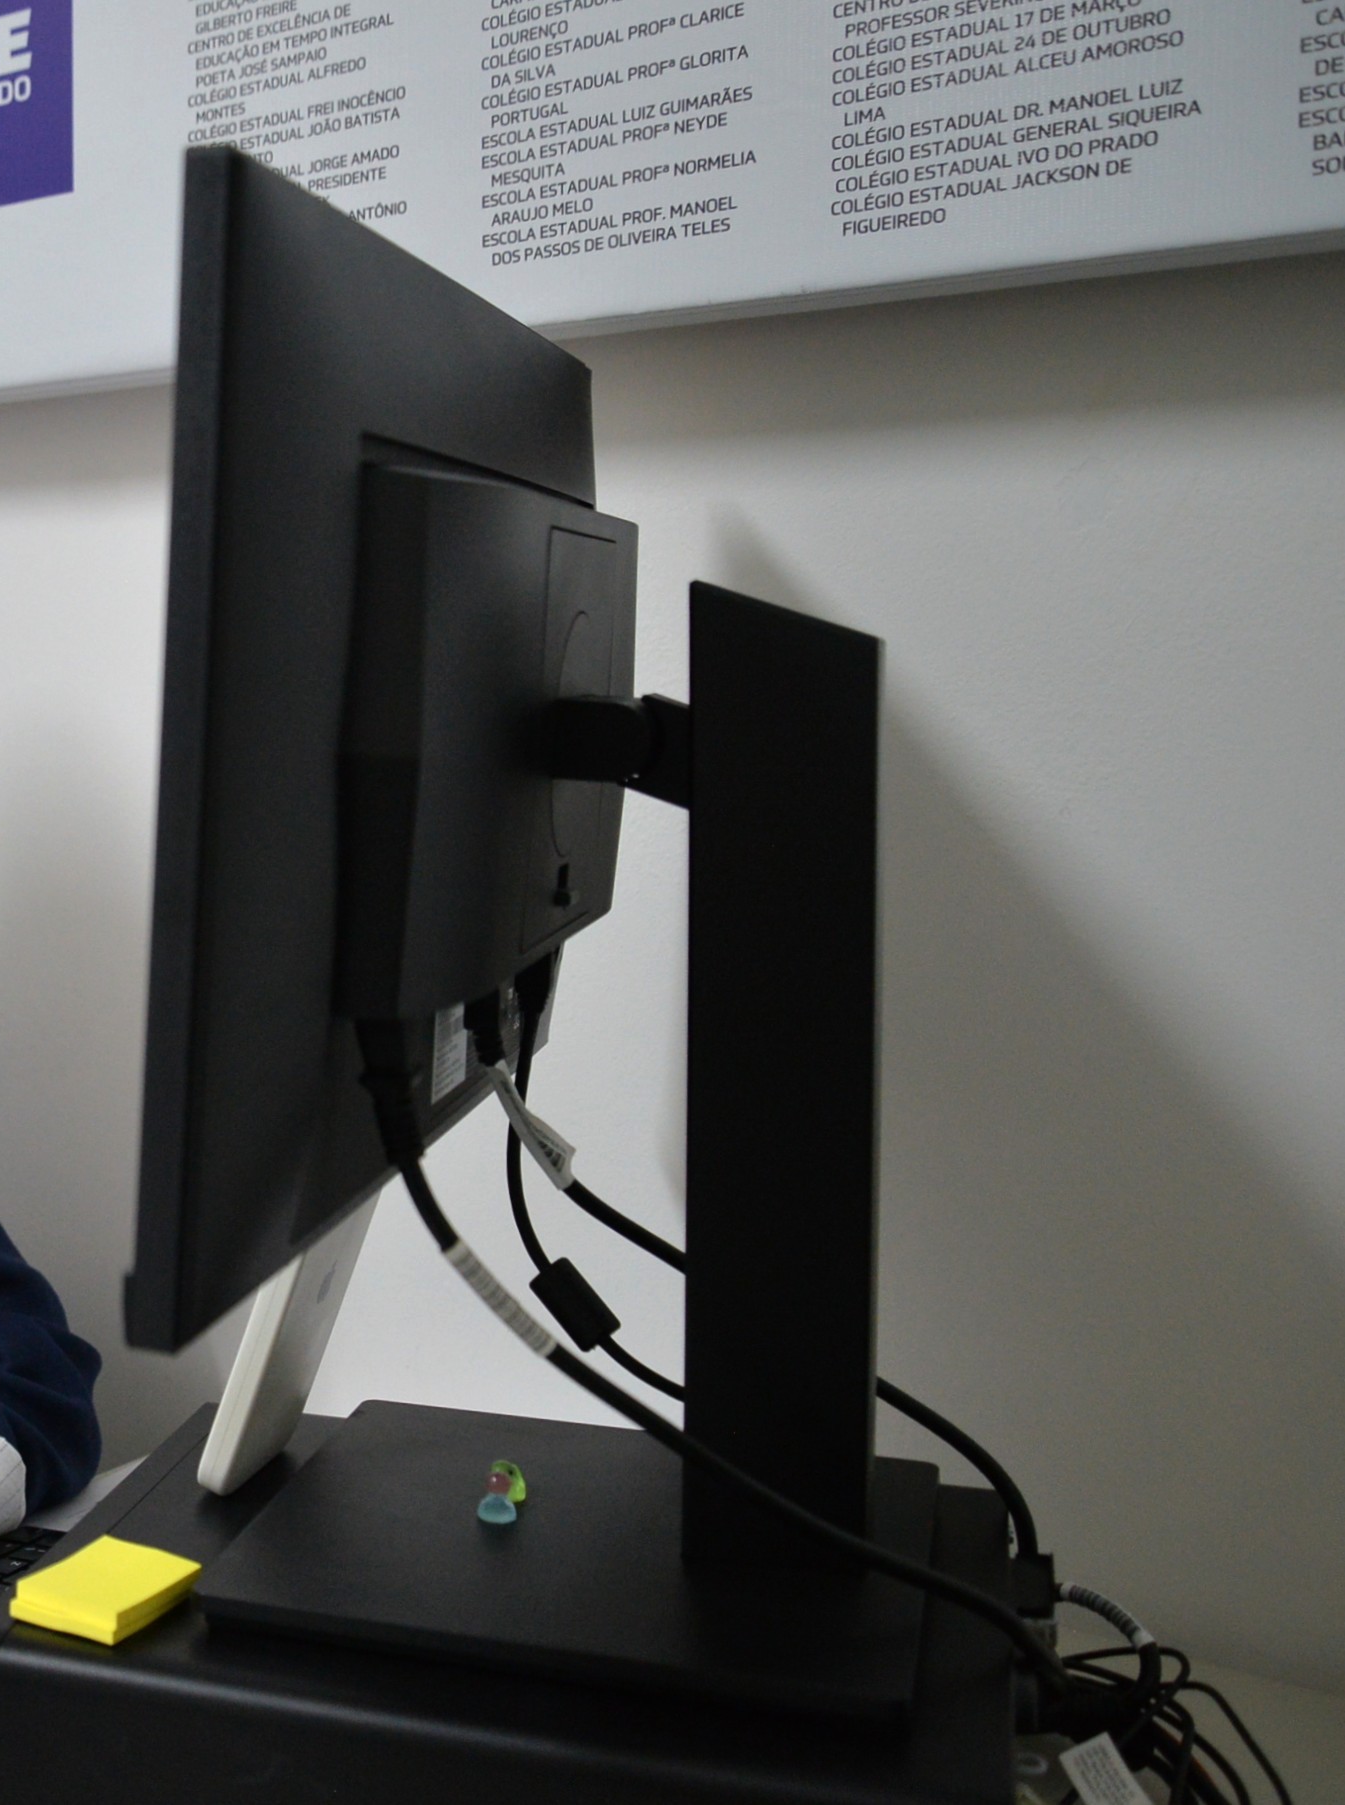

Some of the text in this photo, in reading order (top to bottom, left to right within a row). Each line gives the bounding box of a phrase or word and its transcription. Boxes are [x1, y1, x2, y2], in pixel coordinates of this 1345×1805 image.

[187, 4, 351, 55] CENTRO DE EXCELÊNCIA DE
[195, 0, 301, 35] GILBERTO FREIRE
[196, 12, 394, 71] EDUCAÇÃO EM TEMPO INTEGRAL
[481, 6, 542, 31] COLÉGIO
[481, 46, 541, 71] COLÉGIO
[545, 28, 624, 58] ESTADUAL
[680, 2, 744, 29] CLARICE
[491, 20, 568, 49] LOURENÇO
[832, 35, 906, 63] COLÉGIO
[911, 15, 1010, 48] ESTADUAL
[1015, 11, 1034, 28] 17
[1040, 5, 1065, 23] DE
[844, 5, 950, 38] PROFESSOR
[196, 47, 327, 88] POETA JOSÉ SAMPAIO
[832, 9, 1171, 85] COLÉGIO ESTADUAL 24 DE OUTUBRO
[832, 30, 1184, 107] COLÉGIO ESTADUAL ALCEU AMOROSO
[187, 56, 366, 108] COLÉGIO ESTADUAL ALFREDO
[481, 85, 541, 110] COLÉGIO
[545, 69, 623, 97] ESTADUAL
[680, 44, 749, 71] GLORITA
[491, 63, 556, 89] DA SILVA
[188, 86, 406, 143] COLÉGIO ESTADUAL FREI INOCÊNCIO
[196, 101, 245, 124] MONTES
[241, 126, 304, 150] ESTADUAL
[308, 117, 341, 137] JOÃO
[344, 106, 400, 129] BATISTA
[482, 86, 752, 150] ESCOLA ESTADUAL LUIZ GUIMARÃES
[491, 101, 568, 128] PORTUGAL
[831, 100, 1202, 172] COLÉGIO ESTADUAL GENERAL SIQUEIRA
[832, 79, 1183, 150] COLÉGIO ESTADUAL DR. MANOEL LUIZ
[844, 106, 886, 127] LIMA
[308, 155, 347, 174] JORGE
[351, 145, 399, 166] AMADO
[482, 147, 536, 170] ESCOLA
[540, 132, 618, 159] ESTADUAL
[674, 112, 727, 134] NEYDE
[836, 130, 1158, 193] COLÉGIO ESTADUAL IVO DO PRADO
[307, 168, 387, 190] PRESIDENTE
[482, 187, 536, 209] ESCOLA
[540, 173, 618, 199] ESTADUAL
[674, 150, 756, 176] NORMELIA
[491, 162, 565, 187] MESQUITA
[831, 158, 1131, 216] COLÉGIO ESTADUAL JACKSON DE
[347, 201, 407, 222] ANTÔNIO
[482, 195, 737, 248] ESCOLA ESTADUAL PROF. MANOEL
[491, 198, 593, 227] ARAUJO MELO
[843, 208, 946, 236] FIGUEIREDO
[492, 218, 730, 266] DOS PASSOS DE OLIVEIRA TELES
